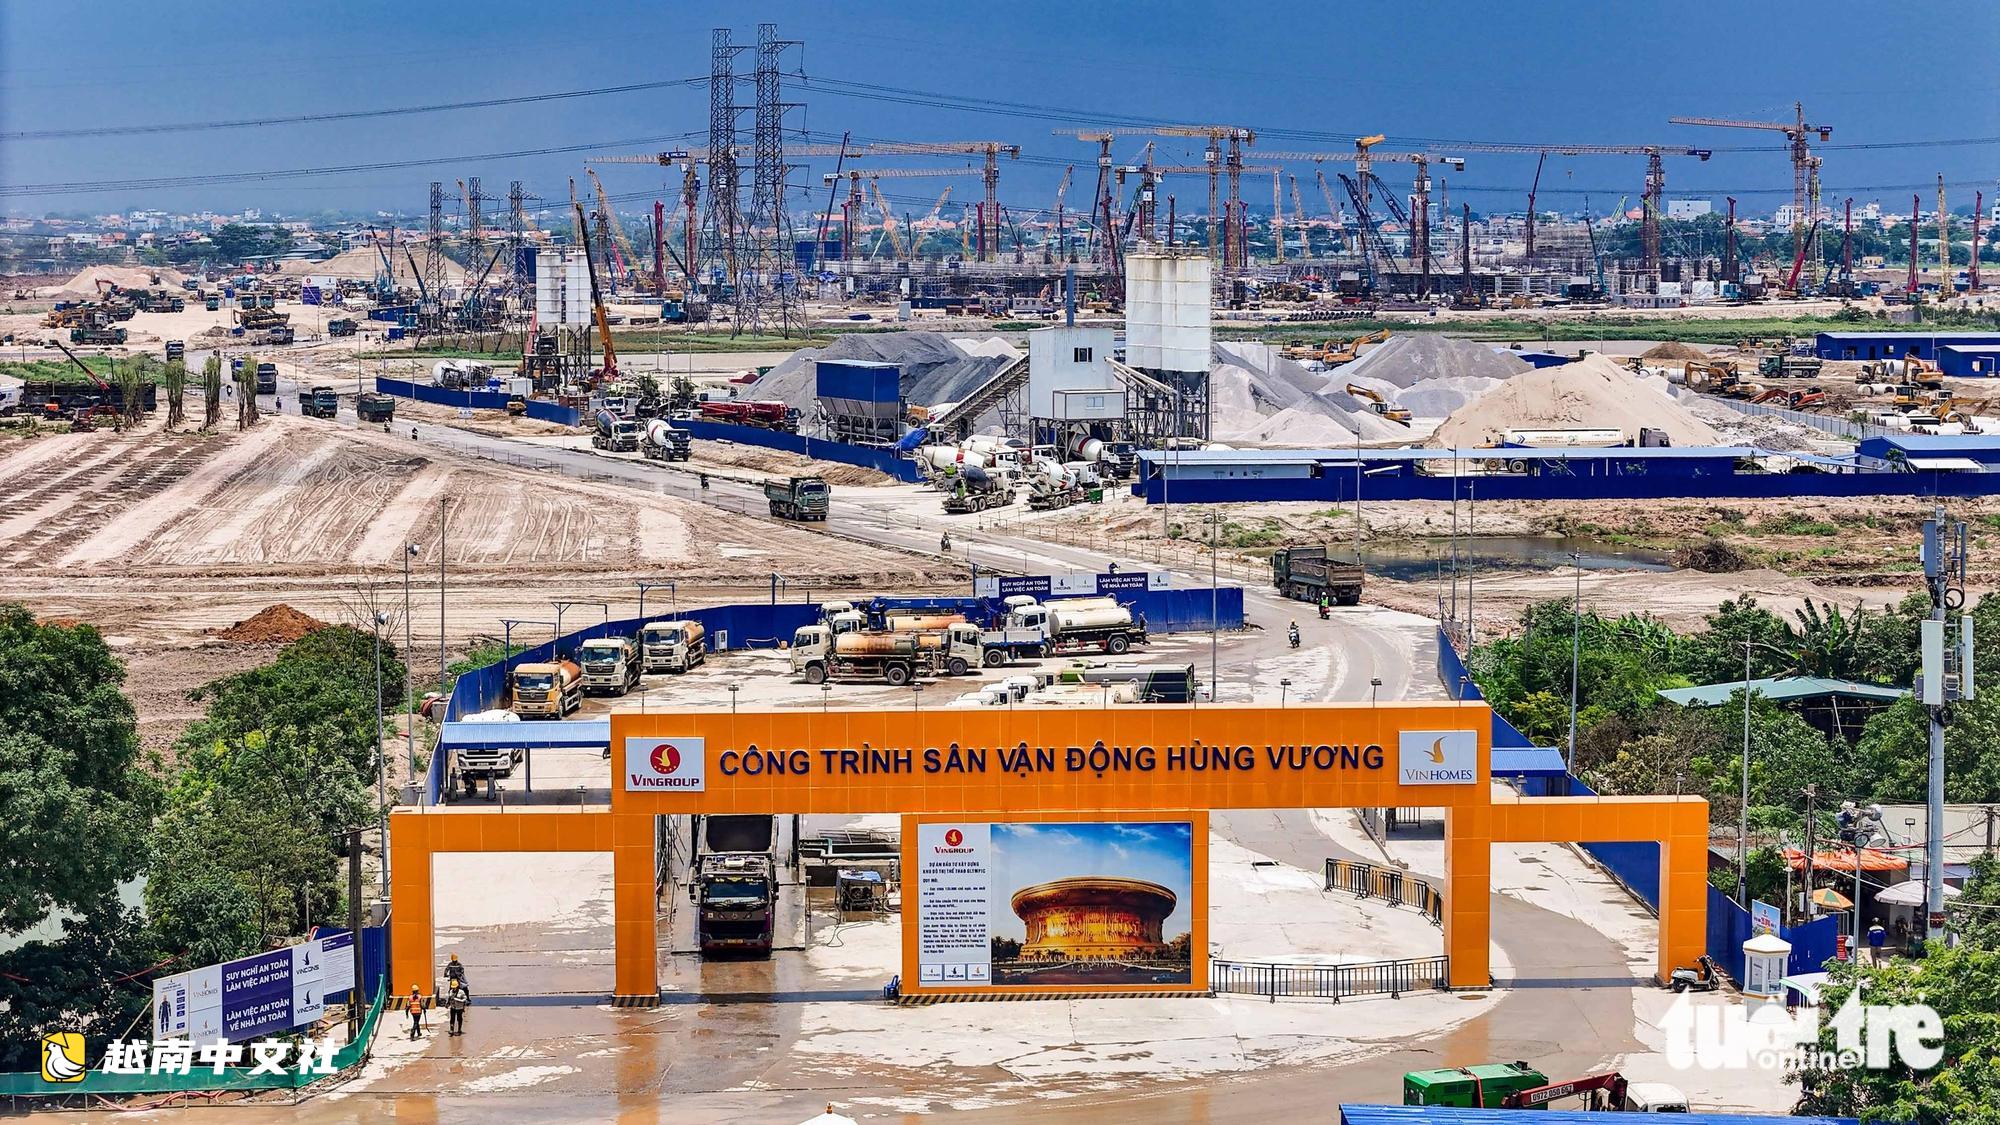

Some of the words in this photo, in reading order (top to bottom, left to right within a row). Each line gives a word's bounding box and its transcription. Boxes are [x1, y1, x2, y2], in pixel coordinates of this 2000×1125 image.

[719, 743, 809, 776] CÔNG
[819, 743, 912, 774] TRÌNH
[923, 743, 986, 773] SÂN
[996, 742, 1054, 777] VẬN
[1064, 740, 1155, 778] ĐỘNG
[1167, 740, 1254, 771] HÙNG
[1265, 744, 1383, 770] VƯƠNG
[631, 773, 699, 787] VINGROUP
[1405, 768, 1473, 780] VINHOMES
[934, 846, 974, 854] VINGROUP
[226, 971, 240, 981] SUY
[240, 964, 258, 978] NGHĨ
[259, 963, 269, 972] AN
[270, 958, 289, 970] TOÀN
[296, 964, 319, 975] VINCONS
[226, 981, 241, 992] LÀM
[242, 977, 258, 989] VIỆC
[270, 969, 289, 981] TOÀN
[226, 1010, 241, 1021] LÀM
[242, 1006, 258, 1017] VIỆC
[259, 1004, 270, 1013] AN
[271, 998, 290, 1010] TOÀN
[296, 1004, 320, 1014] VINCONS
[229, 1021, 240, 1032] VỀ
[240, 1017, 255, 1029] NHÀ
[256, 1015, 267, 1024] AN
[268, 1010, 287, 1022] TOÀN
[1532, 1090, 1548, 1101] 0972
